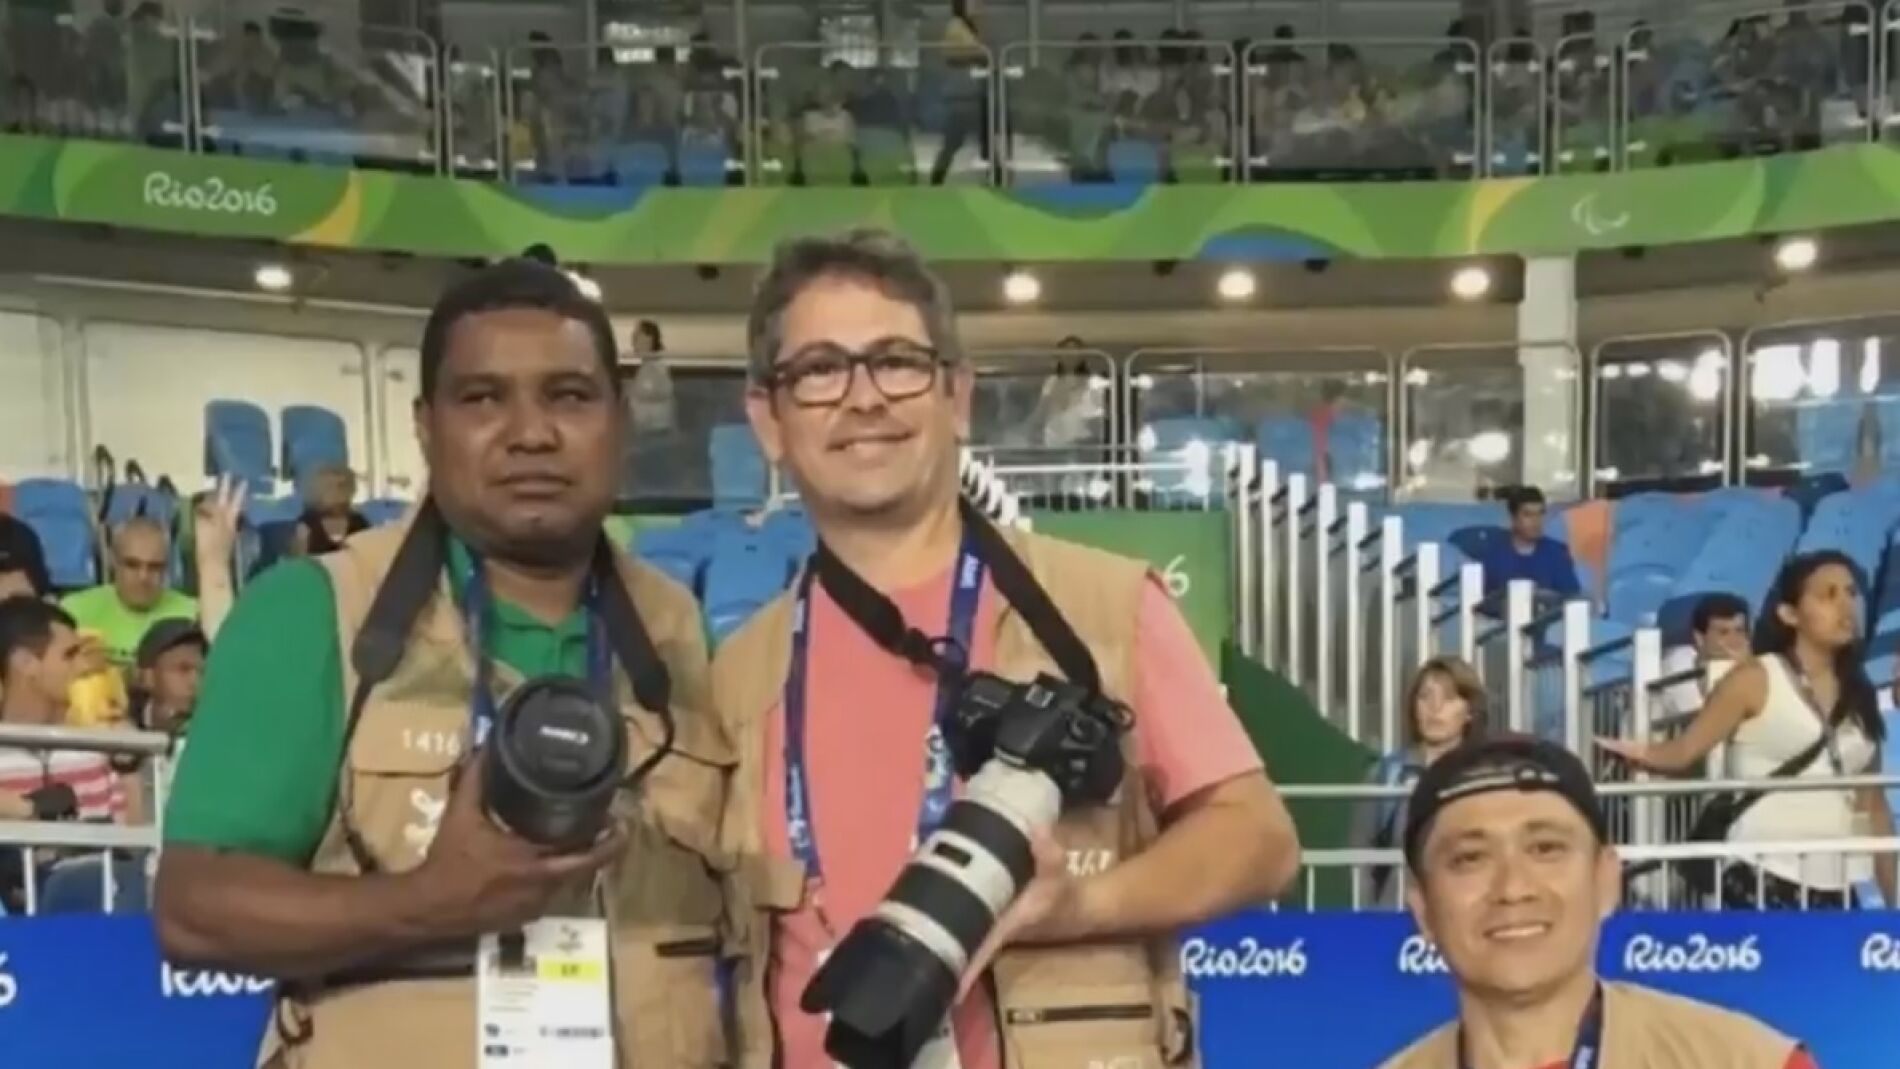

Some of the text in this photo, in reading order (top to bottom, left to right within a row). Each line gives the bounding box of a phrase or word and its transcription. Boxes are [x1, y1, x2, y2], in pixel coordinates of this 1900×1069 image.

[143, 170, 277, 215] Rio2016
[1180, 937, 1307, 977] Rio2016
[1624, 933, 1762, 971] Rio2016
